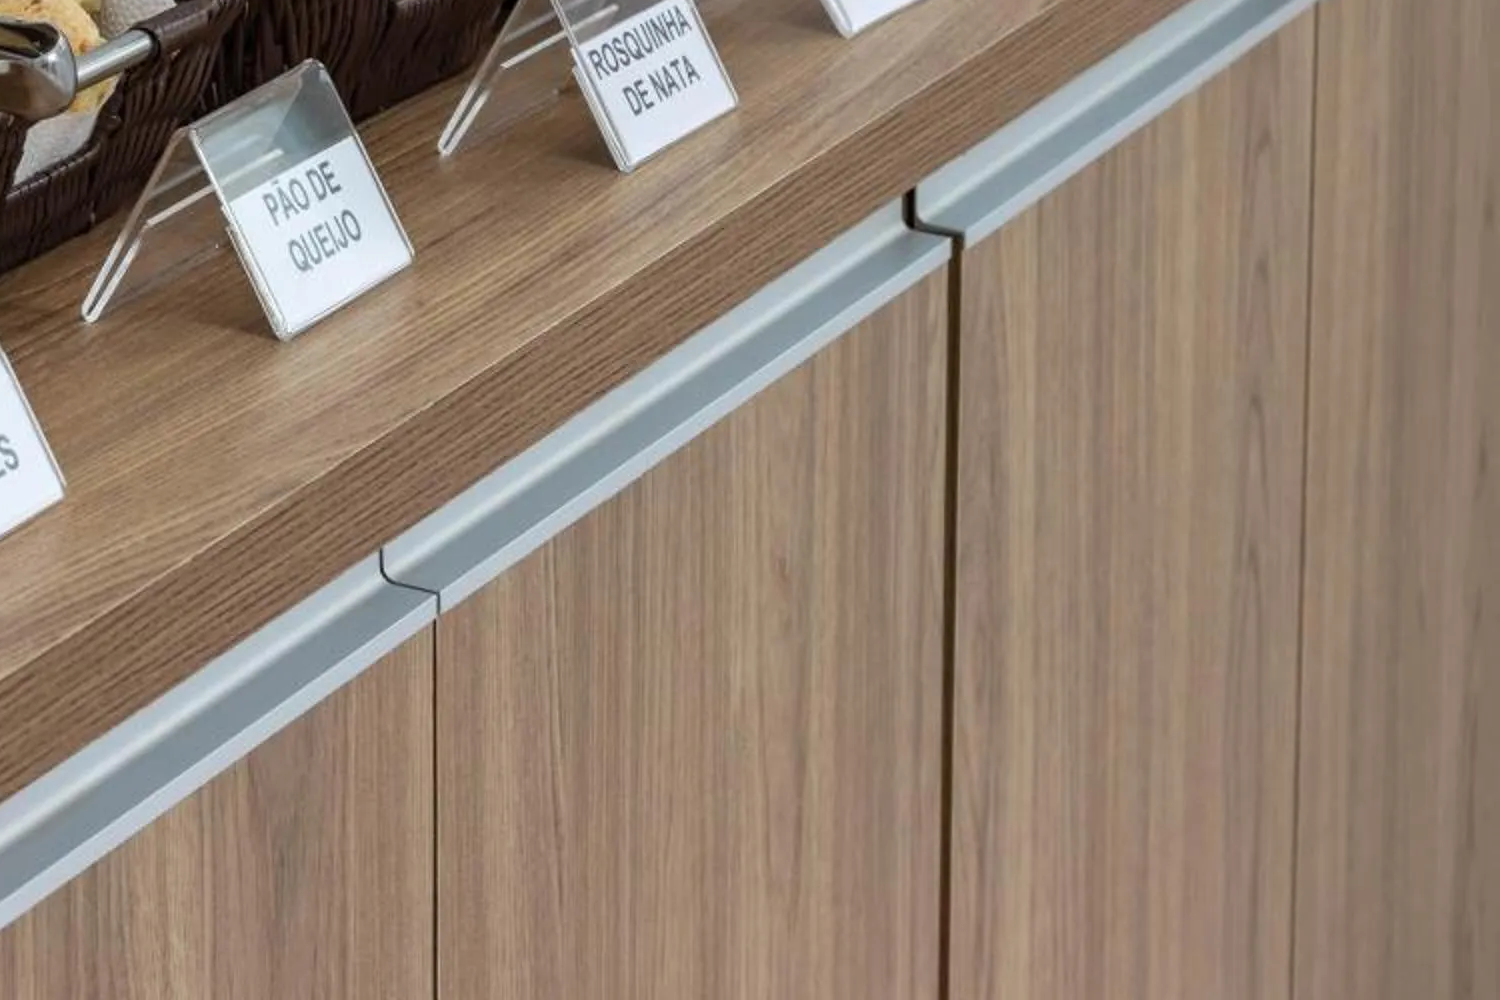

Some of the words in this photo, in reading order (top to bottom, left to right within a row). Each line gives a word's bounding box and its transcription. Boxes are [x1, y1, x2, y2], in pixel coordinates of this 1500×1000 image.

[588, 4, 692, 80] ROSQUINHA
[622, 77, 654, 116] DE
[650, 55, 701, 104] NATA
[262, 178, 310, 226] PÃO
[304, 160, 342, 202] DE
[287, 208, 362, 273] QUEIJO
